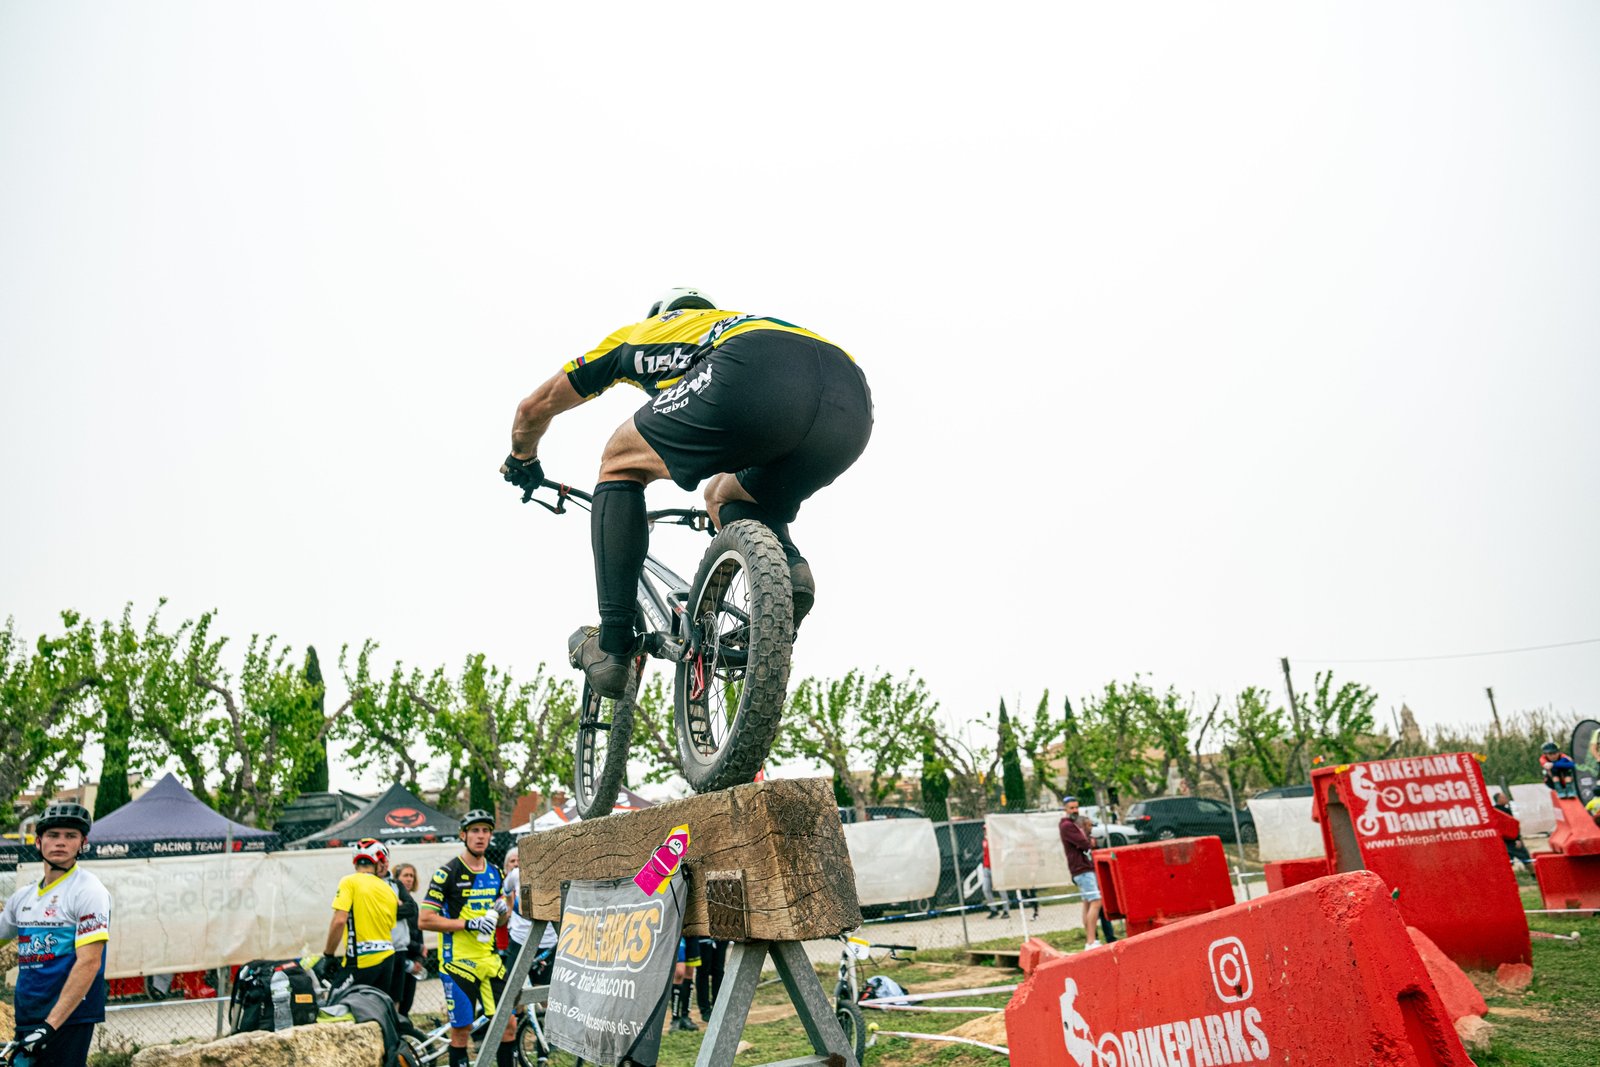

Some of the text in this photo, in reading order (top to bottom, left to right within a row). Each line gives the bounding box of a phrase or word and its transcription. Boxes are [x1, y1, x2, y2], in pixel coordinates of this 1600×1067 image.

[634, 347, 691, 374] heb
[1369, 755, 1462, 782] BIKEPARK
[1405, 779, 1471, 804] Costa
[1384, 805, 1480, 833] Daurada
[154, 842, 192, 852] RACING
[195, 841, 222, 851] TEAM
[674, 840, 682, 849] 5
[1365, 828, 1496, 850] www.bikeparktdb.com
[1122, 1007, 1270, 1067] BIKEPARKS
